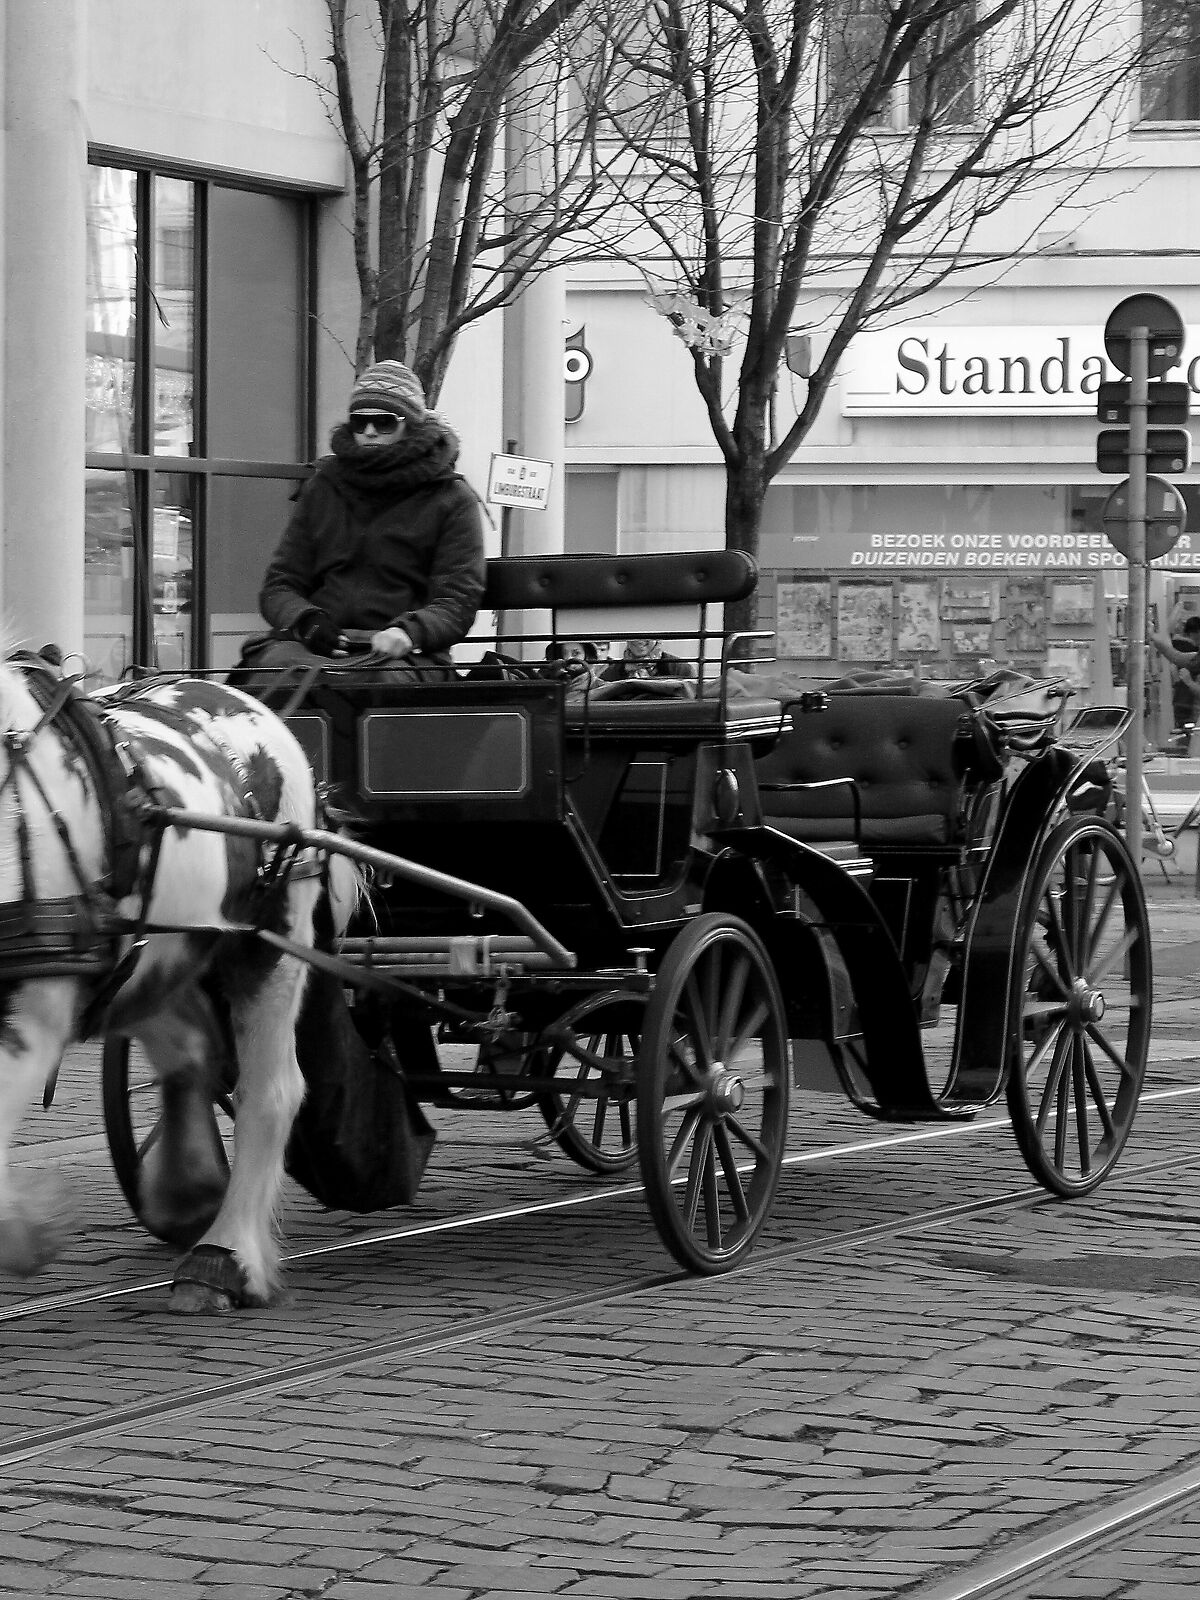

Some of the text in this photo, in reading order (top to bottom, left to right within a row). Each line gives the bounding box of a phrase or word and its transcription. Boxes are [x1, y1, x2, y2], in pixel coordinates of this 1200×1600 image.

[896, 336, 1200, 395] Standa
[871, 534, 1191, 549] BEZOEK ONZE VOORDEELR
[850, 551, 960, 566] DUIZENDEN
[964, 552, 1041, 566] BOEKEN
[1045, 552, 1081, 566] AAN
